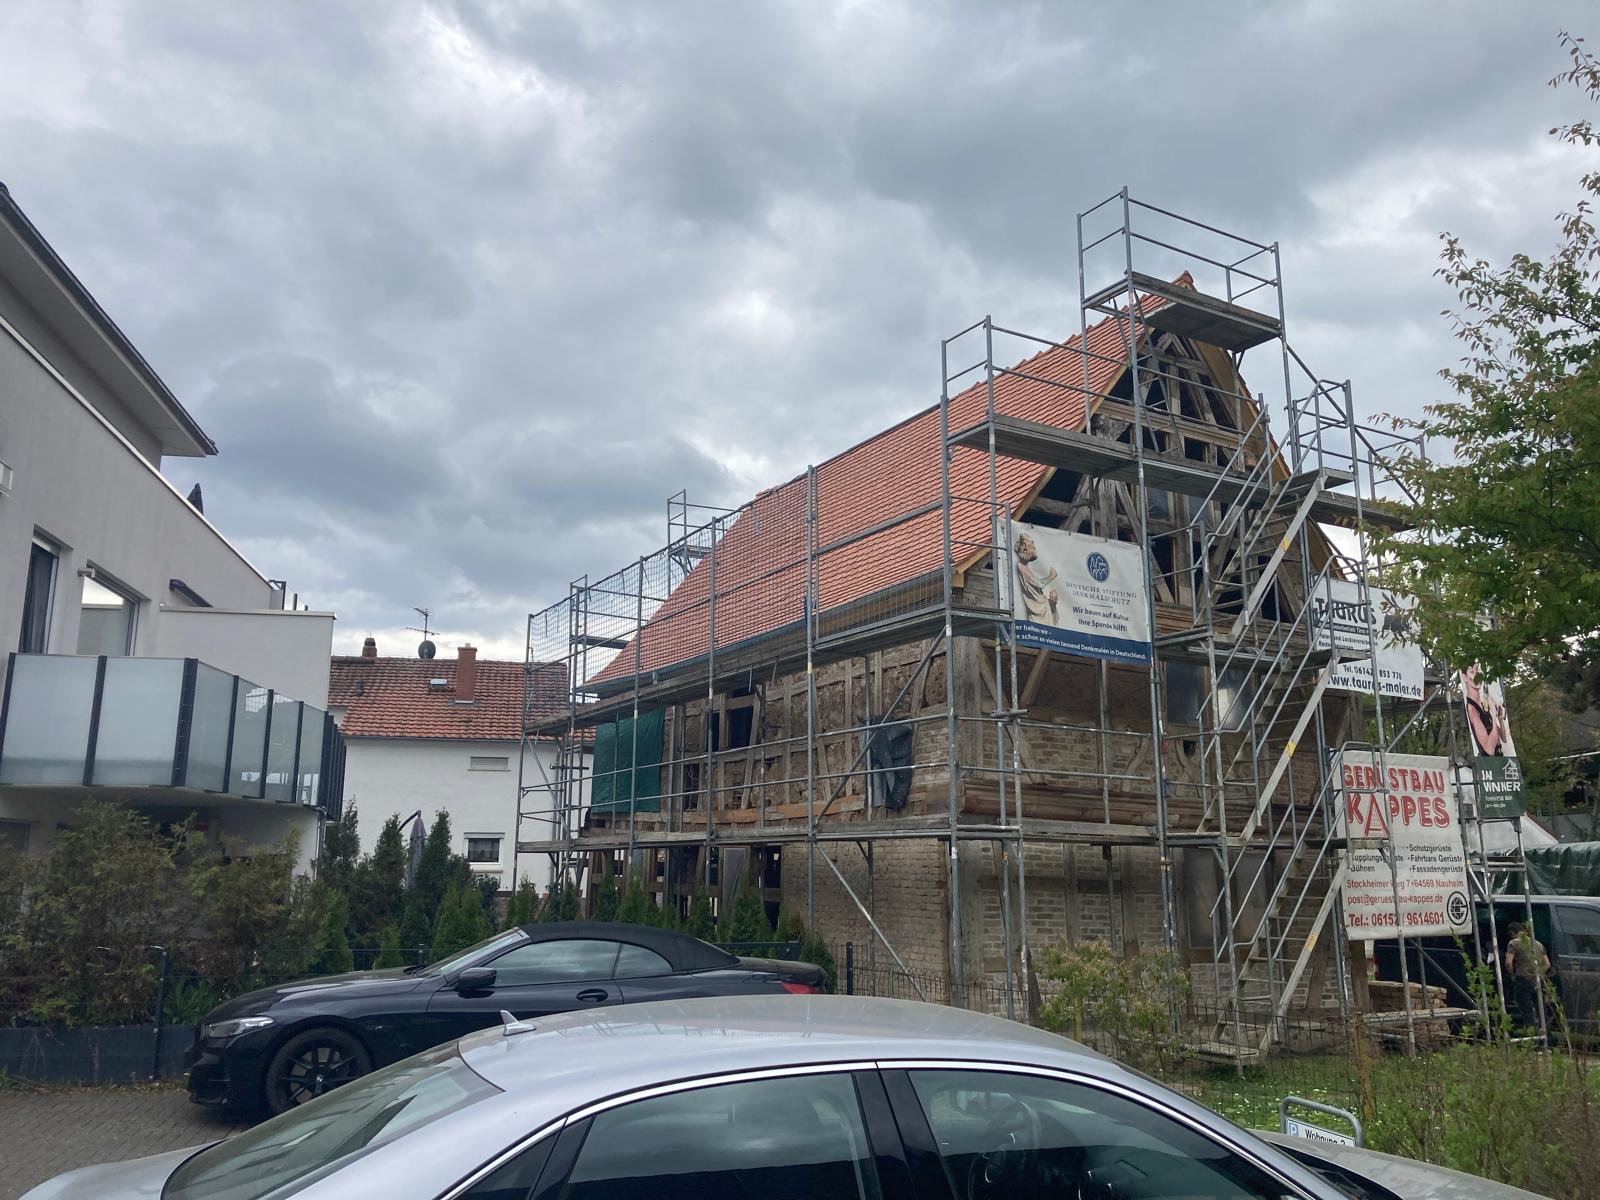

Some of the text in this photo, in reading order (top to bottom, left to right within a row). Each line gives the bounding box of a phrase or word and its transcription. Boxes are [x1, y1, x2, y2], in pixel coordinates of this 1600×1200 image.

[1066, 581, 1137, 599] DEUTSCHE STIFTUNG
[1072, 589, 1131, 605] DENKMALSCHUTZ
[1072, 606, 1084, 614] Wir
[1078, 618, 1090, 627] Ihre
[1091, 619, 1113, 629] Spende
[1021, 633, 1039, 641] schon
[1342, 664, 1353, 673] Tel.
[1327, 675, 1422, 697] ww.taurs-maler.de
[1346, 791, 1450, 837] KAPPES
[1346, 880, 1389, 889] Stockheimer
[1347, 894, 1444, 906] post@geruestau-kappes.de
[1348, 913, 1369, 927] Tel.:
[1406, 911, 1445, 925] 9614601
